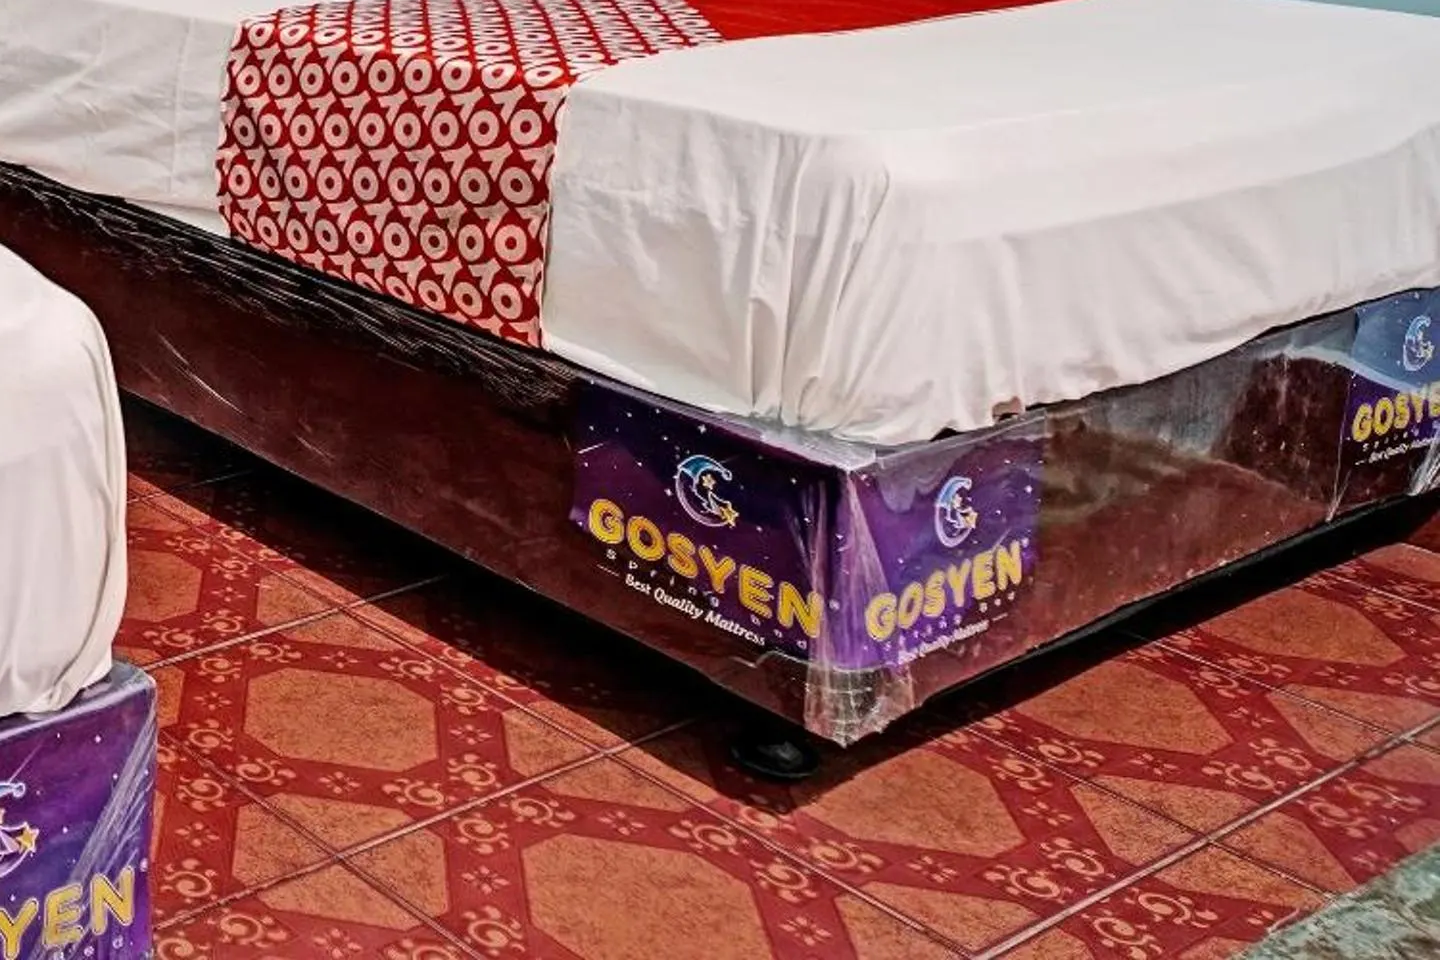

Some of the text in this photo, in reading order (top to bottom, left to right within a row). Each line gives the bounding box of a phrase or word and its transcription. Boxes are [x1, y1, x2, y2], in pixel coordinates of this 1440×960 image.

[588, 498, 824, 638] GOSYEN
[625, 573, 766, 646] Best Quality Mattress
[865, 539, 1022, 641] GOSYEN
